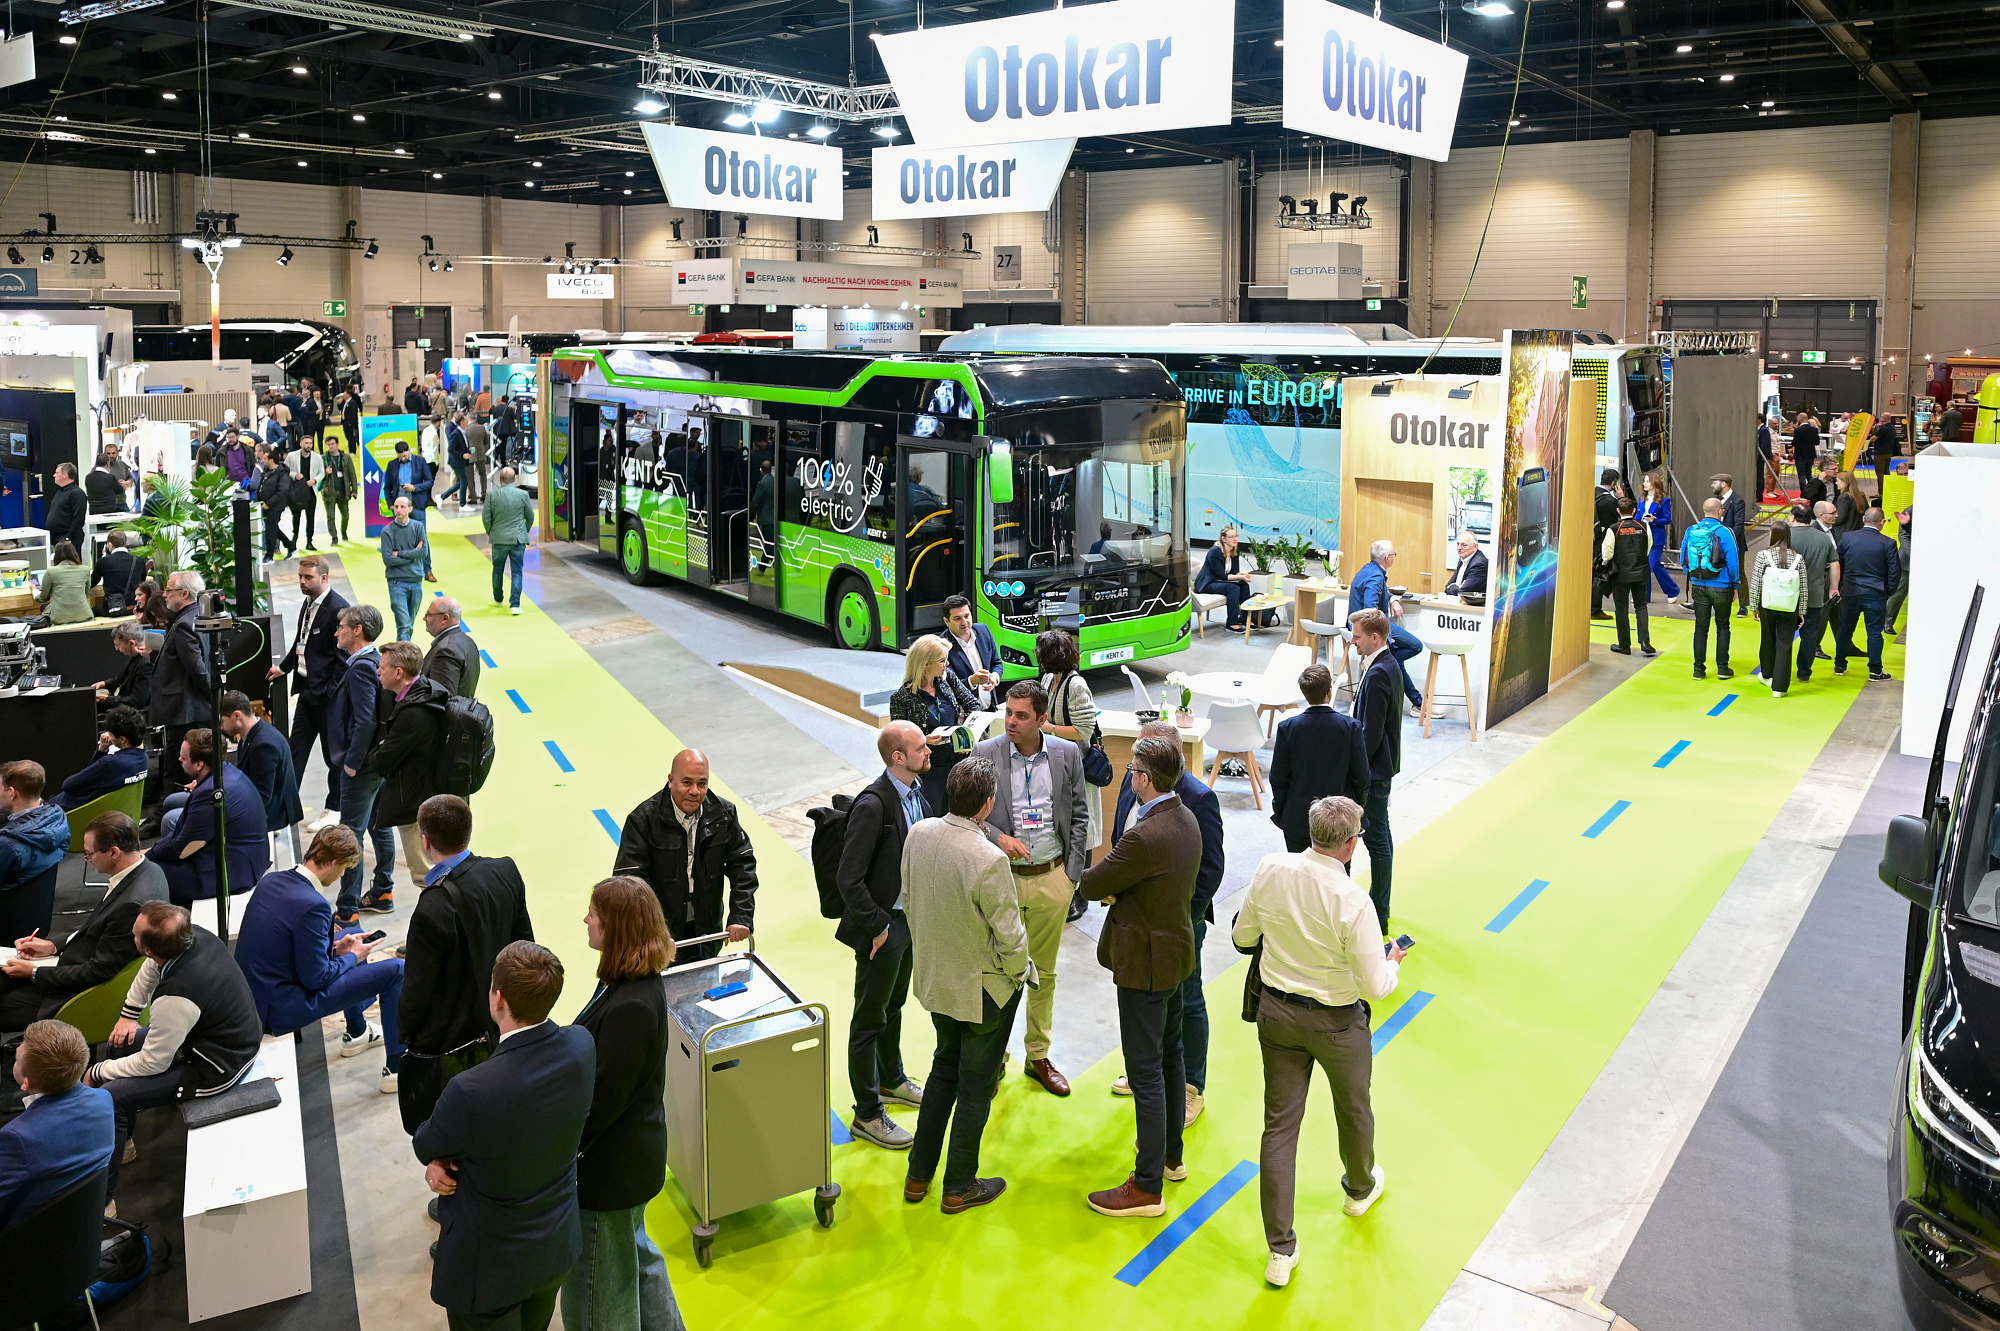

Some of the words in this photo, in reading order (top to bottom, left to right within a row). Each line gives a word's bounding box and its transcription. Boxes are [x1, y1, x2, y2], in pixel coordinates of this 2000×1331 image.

[964, 35, 1172, 123] Otokar
[1322, 28, 1426, 134] Otokar
[704, 145, 817, 204] Otokar
[899, 153, 1017, 205] Otokar
[997, 254, 1013, 268] 27
[688, 274, 706, 282] GEFA
[707, 273, 726, 281] BANK
[1290, 266, 1336, 275] GEOTAB
[1340, 266, 1362, 276] GEOTAB
[756, 274, 775, 282] GEFA
[776, 275, 796, 283] BANK
[802, 276, 846, 285] NACHHALTIG
[847, 277, 866, 285] NACH
[867, 278, 890, 286] VORNE
[890, 279, 913, 287] GEHEN.
[928, 280, 943, 288] GEFA
[1229, 389, 1243, 405] IN
[1390, 412, 1490, 449] Otokar
[621, 456, 653, 483] KENT
[654, 463, 663, 486] C
[797, 456, 854, 496] 100%
[801, 492, 853, 522] electric
[882, 530, 887, 539] C
[1094, 587, 1129, 601] OTOKAR
[1437, 614, 1482, 632] Otokar
[1100, 652, 1119, 662] e-KENT
